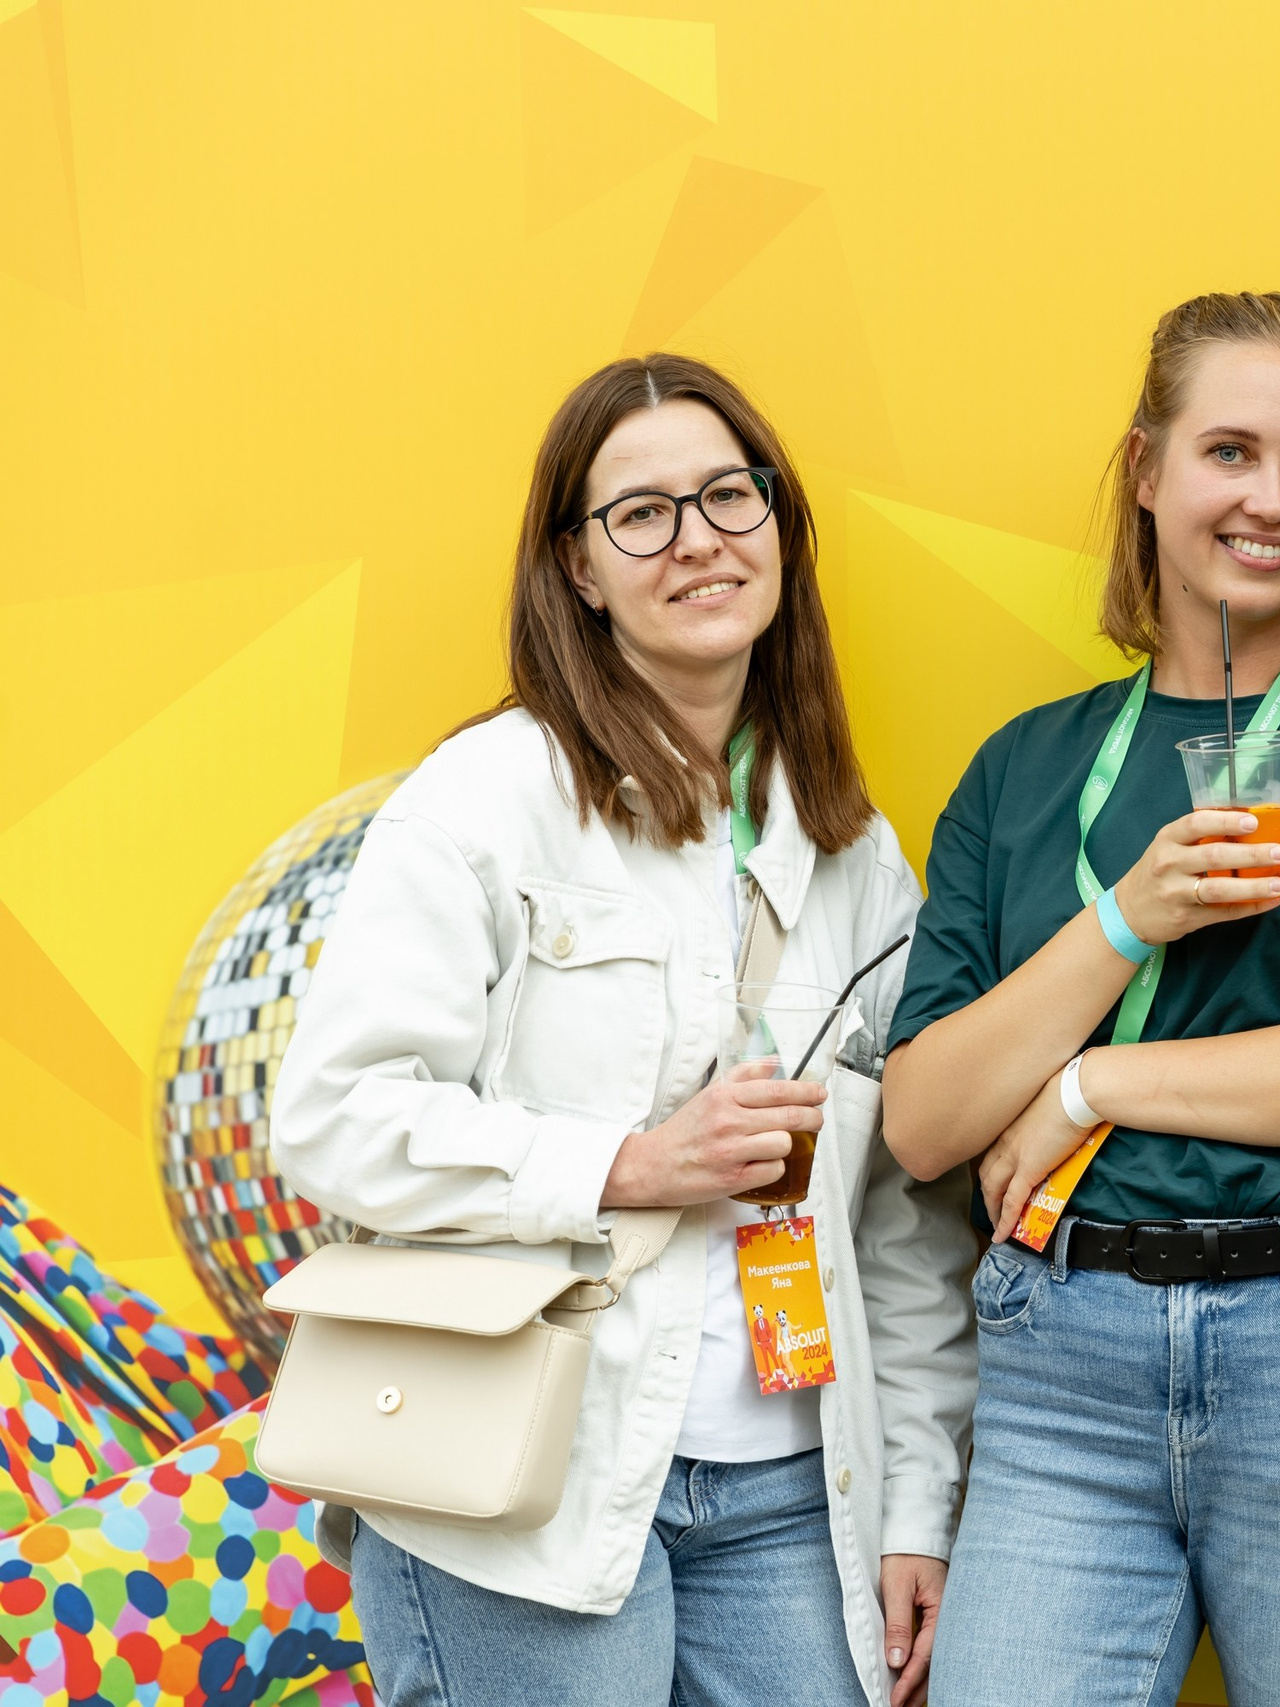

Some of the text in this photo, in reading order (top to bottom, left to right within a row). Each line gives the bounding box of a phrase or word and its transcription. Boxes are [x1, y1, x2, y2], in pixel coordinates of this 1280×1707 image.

[1027, 1193, 1066, 1214] ABSOLUT
[1037, 1208, 1057, 1227] 2024
[747, 1260, 811, 1278] Макеенкова
[772, 1277, 793, 1290] Яна
[776, 1327, 826, 1356] ABSOLUT
[802, 1343, 828, 1360] 2024
